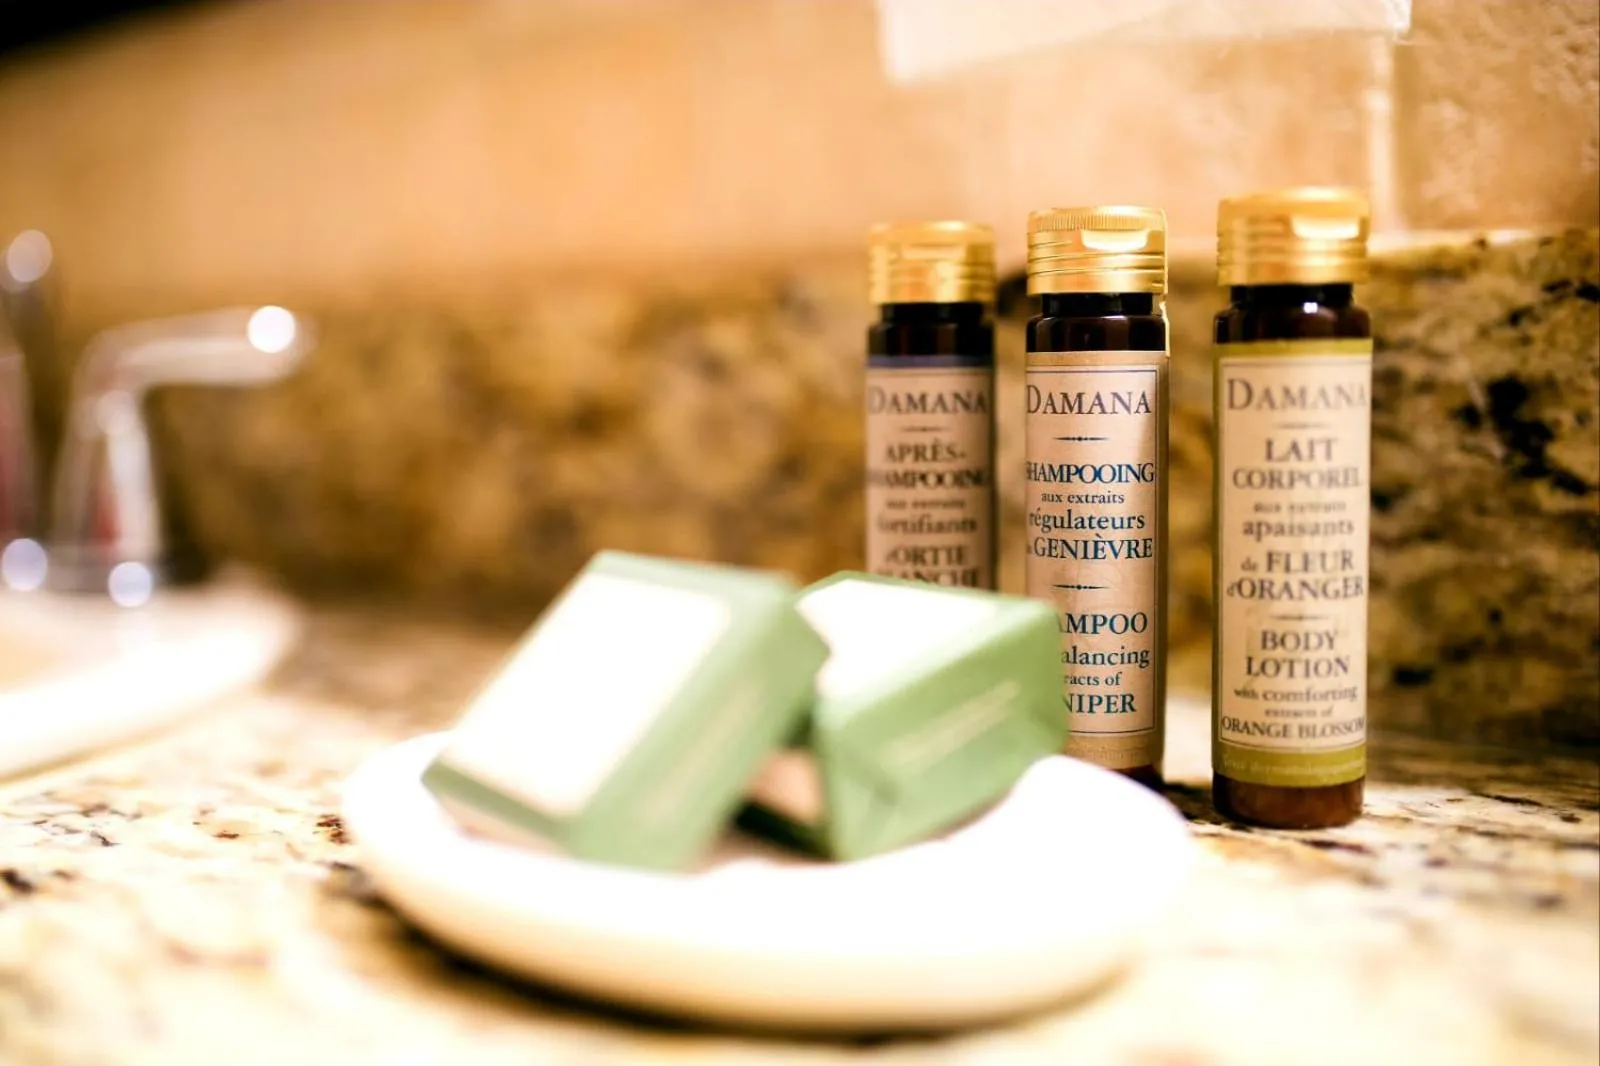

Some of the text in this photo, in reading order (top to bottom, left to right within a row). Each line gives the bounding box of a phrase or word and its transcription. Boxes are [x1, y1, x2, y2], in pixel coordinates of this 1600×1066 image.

[869, 386, 990, 414] DAMANA
[1026, 385, 1152, 414] DAMANA
[1227, 378, 1367, 411] DAMANA
[1265, 437, 1338, 462] LAIT
[1233, 468, 1363, 490] CORPOREL
[1041, 490, 1125, 504] aux extraits
[1029, 508, 1146, 533] régulateurs
[1242, 518, 1354, 542] apaisants
[1034, 534, 1153, 560] GENIÈVRE
[1241, 550, 1354, 574] de FLEUR
[1057, 612, 1149, 635] MPOO
[1260, 629, 1338, 651] BODY
[1061, 646, 1150, 668] alancing
[1245, 656, 1350, 679] LOTION
[1064, 672, 1123, 686] racts of
[1062, 693, 1137, 714] NIPER
[1222, 715, 1294, 738] ORANGE
